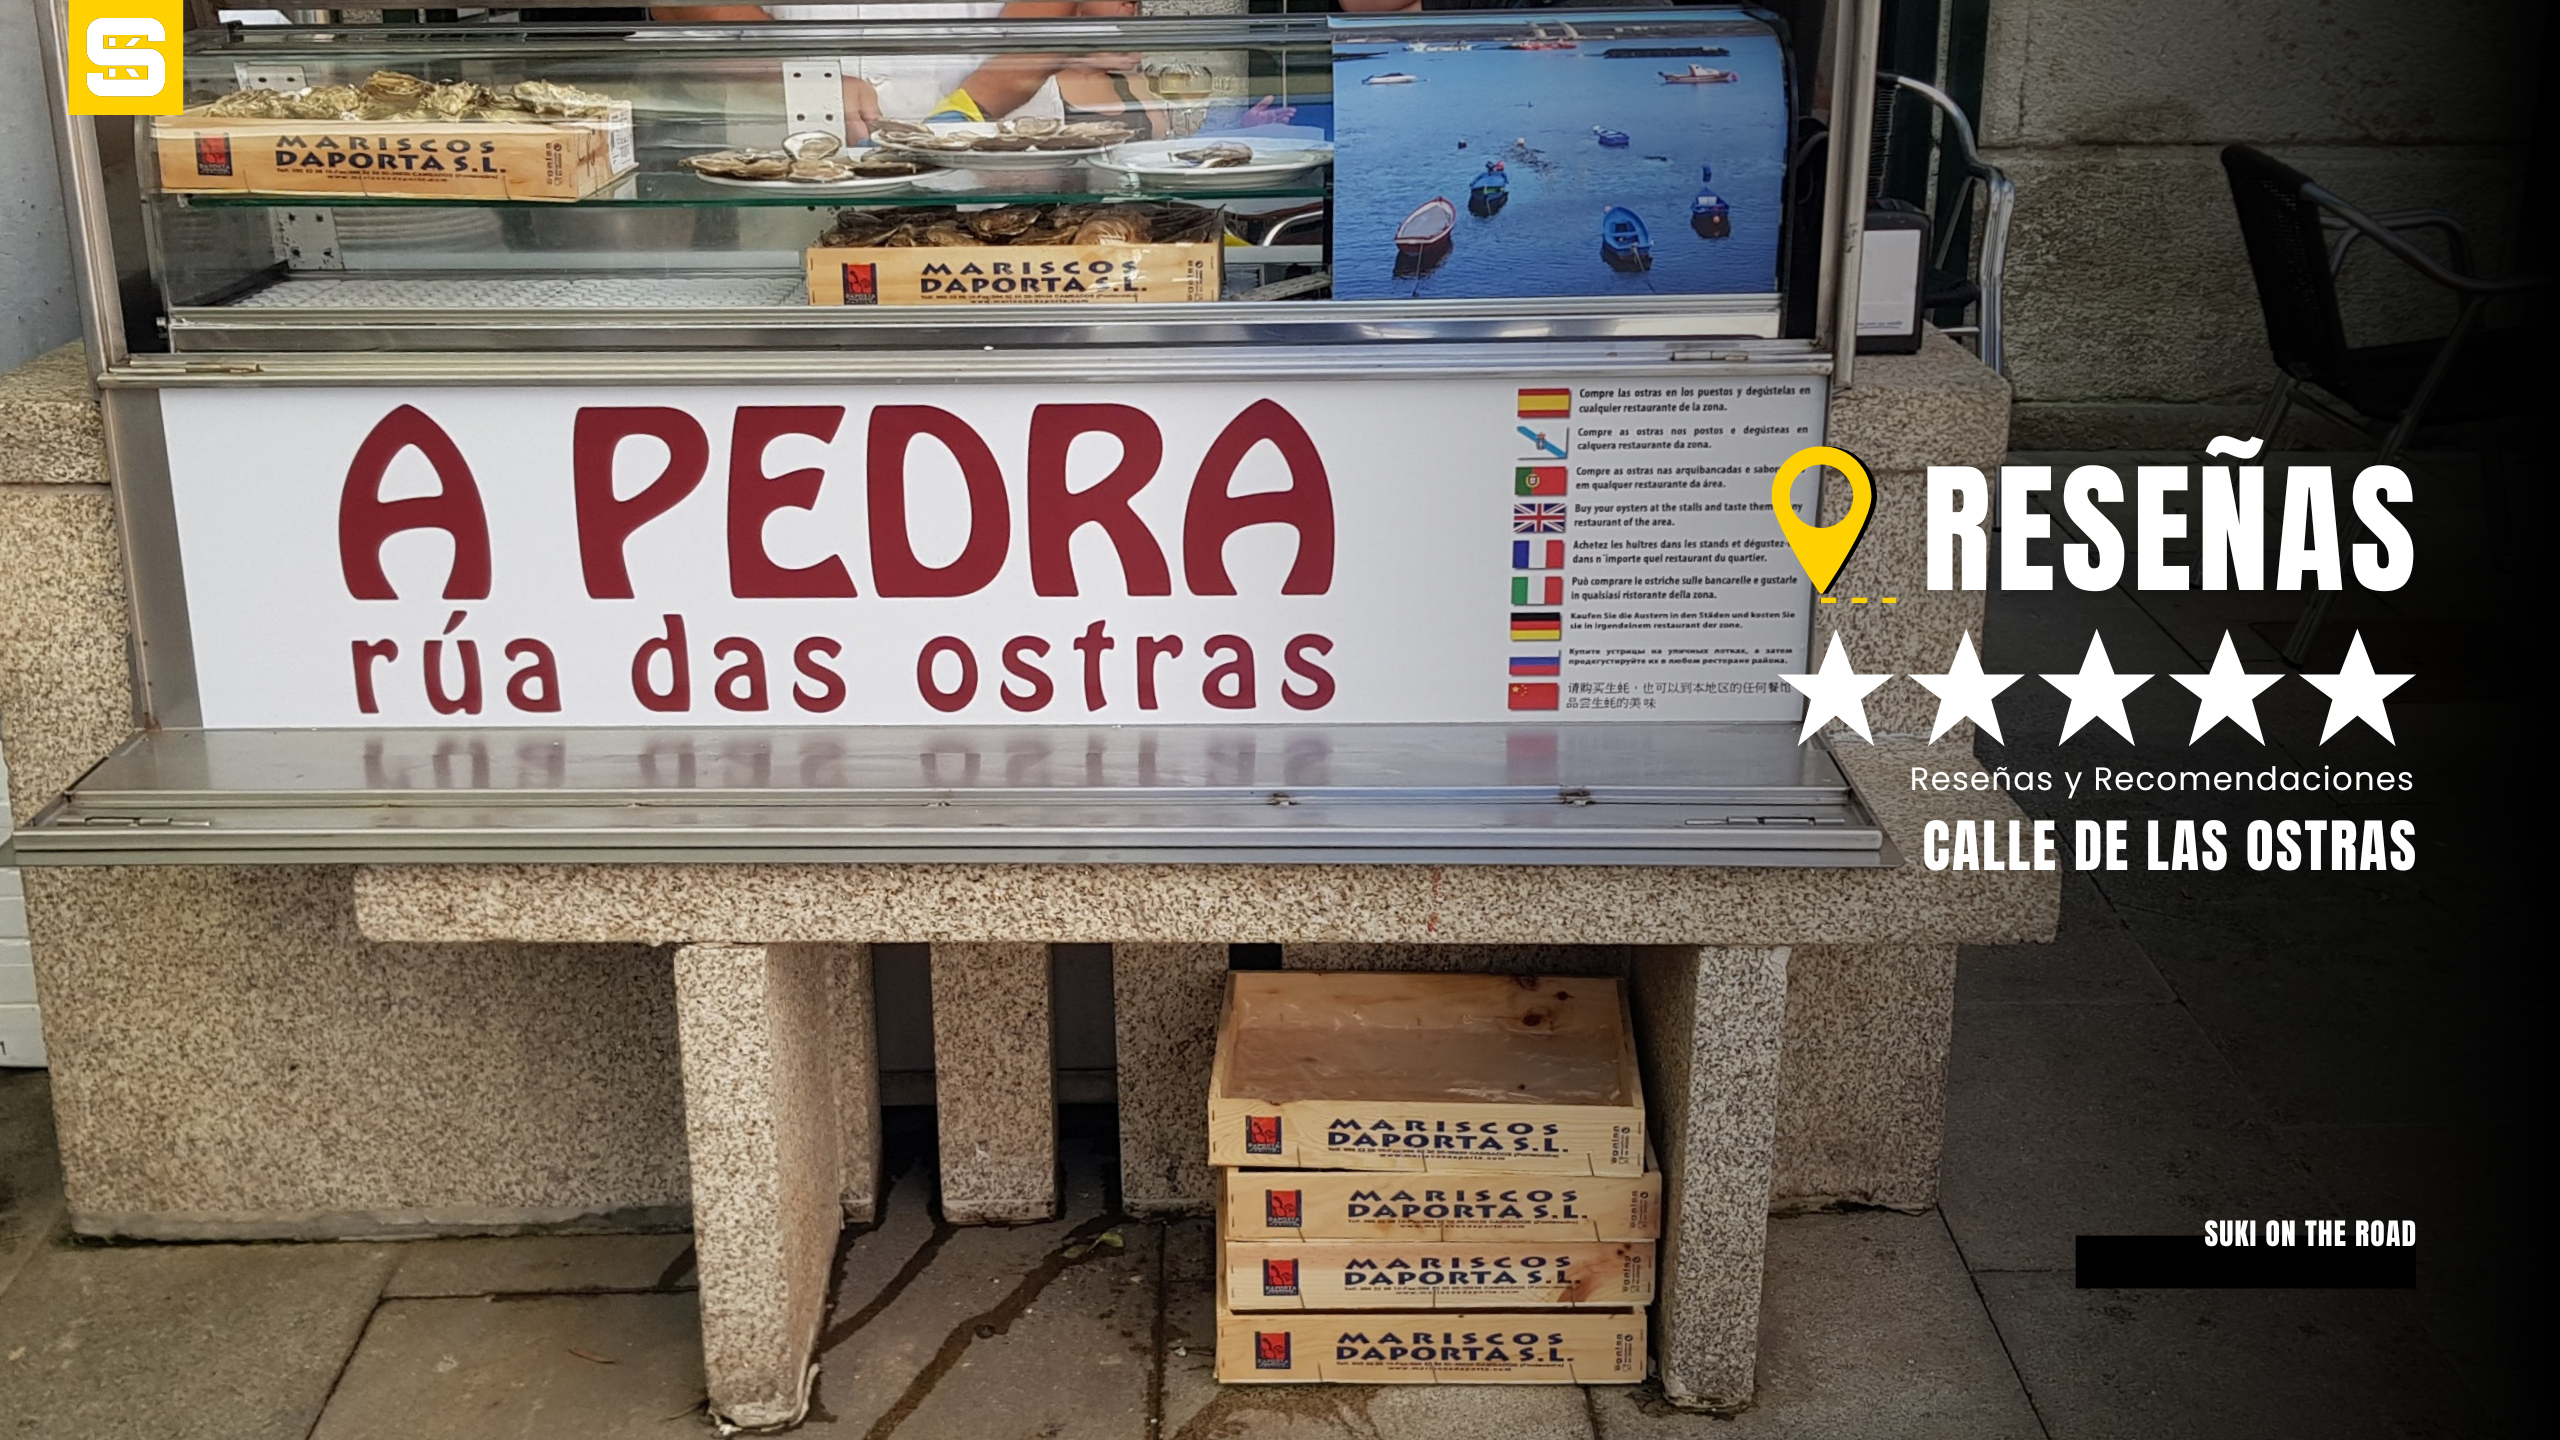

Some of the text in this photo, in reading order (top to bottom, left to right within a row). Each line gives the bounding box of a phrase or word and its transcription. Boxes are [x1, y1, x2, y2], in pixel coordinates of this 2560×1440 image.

[276, 135, 495, 154] MARISCOS
[275, 150, 445, 171] DAPORTA
[454, 156, 506, 174] S.L.
[922, 260, 1136, 276] MARISCOS
[920, 277, 1087, 293] DAPORTA
[1580, 388, 1615, 400] Compre
[1618, 388, 1631, 398] las
[1635, 388, 1662, 398] ostras
[1666, 389, 1678, 397] en
[1681, 386, 1694, 397] los
[1698, 388, 1733, 399] puestos
[1737, 388, 1743, 398] y
[1746, 385, 1796, 398] degústelas
[1579, 402, 1728, 416] cualquier restaurante de la zona.
[1578, 428, 1613, 439] Compre
[1636, 428, 1664, 436] ostras
[1694, 427, 1724, 437] postos
[1743, 425, 1790, 436] degústeas
[1577, 440, 1617, 452] calquera
[1618, 441, 1672, 450] restaurante
[1674, 440, 1686, 449] da
[1576, 467, 1611, 478] Compre
[1627, 467, 1654, 476] ostras
[1676, 465, 1742, 477] arquibancadas
[1592, 480, 1633, 492] qualquer
[1635, 480, 1688, 489] restaurante
[1690, 479, 1701, 489] da
[1703, 479, 1726, 488] área.
[340, 399, 1334, 599] A PEDRA
[1575, 504, 1592, 515] Buy
[1594, 505, 1615, 515] your
[1616, 504, 1648, 515] oysters
[1650, 504, 1660, 512] at
[1662, 503, 1677, 512] the
[1679, 502, 1703, 512] stalls
[1705, 502, 1723, 512] and
[1724, 503, 1747, 512] taste
[1749, 502, 1773, 511] them
[1574, 518, 1622, 527] restaurant
[1623, 517, 1634, 527] of
[1635, 517, 1651, 527] the
[1573, 540, 1609, 550] Achetez
[1611, 539, 1624, 549] les
[1660, 539, 1682, 549] dans
[1684, 539, 1697, 549] les
[1700, 538, 1729, 549] stands
[1732, 540, 1742, 548] et
[1744, 538, 1790, 550] dégustez-
[1573, 554, 1594, 564] dans
[1643, 553, 1664, 565] quel
[1665, 554, 1713, 563] restaurant
[1714, 553, 1726, 563] du
[1728, 553, 1768, 565] quartier.
[1572, 576, 1589, 586] Può
[1591, 578, 1633, 588] comprare
[1635, 576, 1643, 586] le
[1645, 576, 1681, 586] ostriche
[1682, 576, 1703, 585] sulle
[1705, 575, 1752, 585] bancarelle
[1761, 575, 1798, 587] gustarle
[1571, 591, 1580, 600] in
[1582, 590, 1621, 602] qualsiasi
[1623, 590, 1667, 600] ristorante
[1669, 590, 1691, 599] della
[1595, 622, 1652, 631] irgendeinem
[1569, 648, 1601, 656] Купите
[353, 611, 1334, 713] rúa das ostras
[1568, 658, 1647, 666] продегустируйте
[1751, 657, 1789, 666] района.
[1329, 1118, 1558, 1135] MARISCOS
[1328, 1132, 1568, 1152] DAPORTA S.L.
[1350, 1190, 1578, 1202] MARISCOS
[1348, 1204, 1588, 1219] DAPORTA S.L.
[1345, 1256, 1571, 1270] MARISCOS
[1344, 1270, 1581, 1286] DAPORTA S.L.
[1338, 1332, 1564, 1345] MARISCOS
[1336, 1346, 1574, 1362] DAPORTA S.L.
